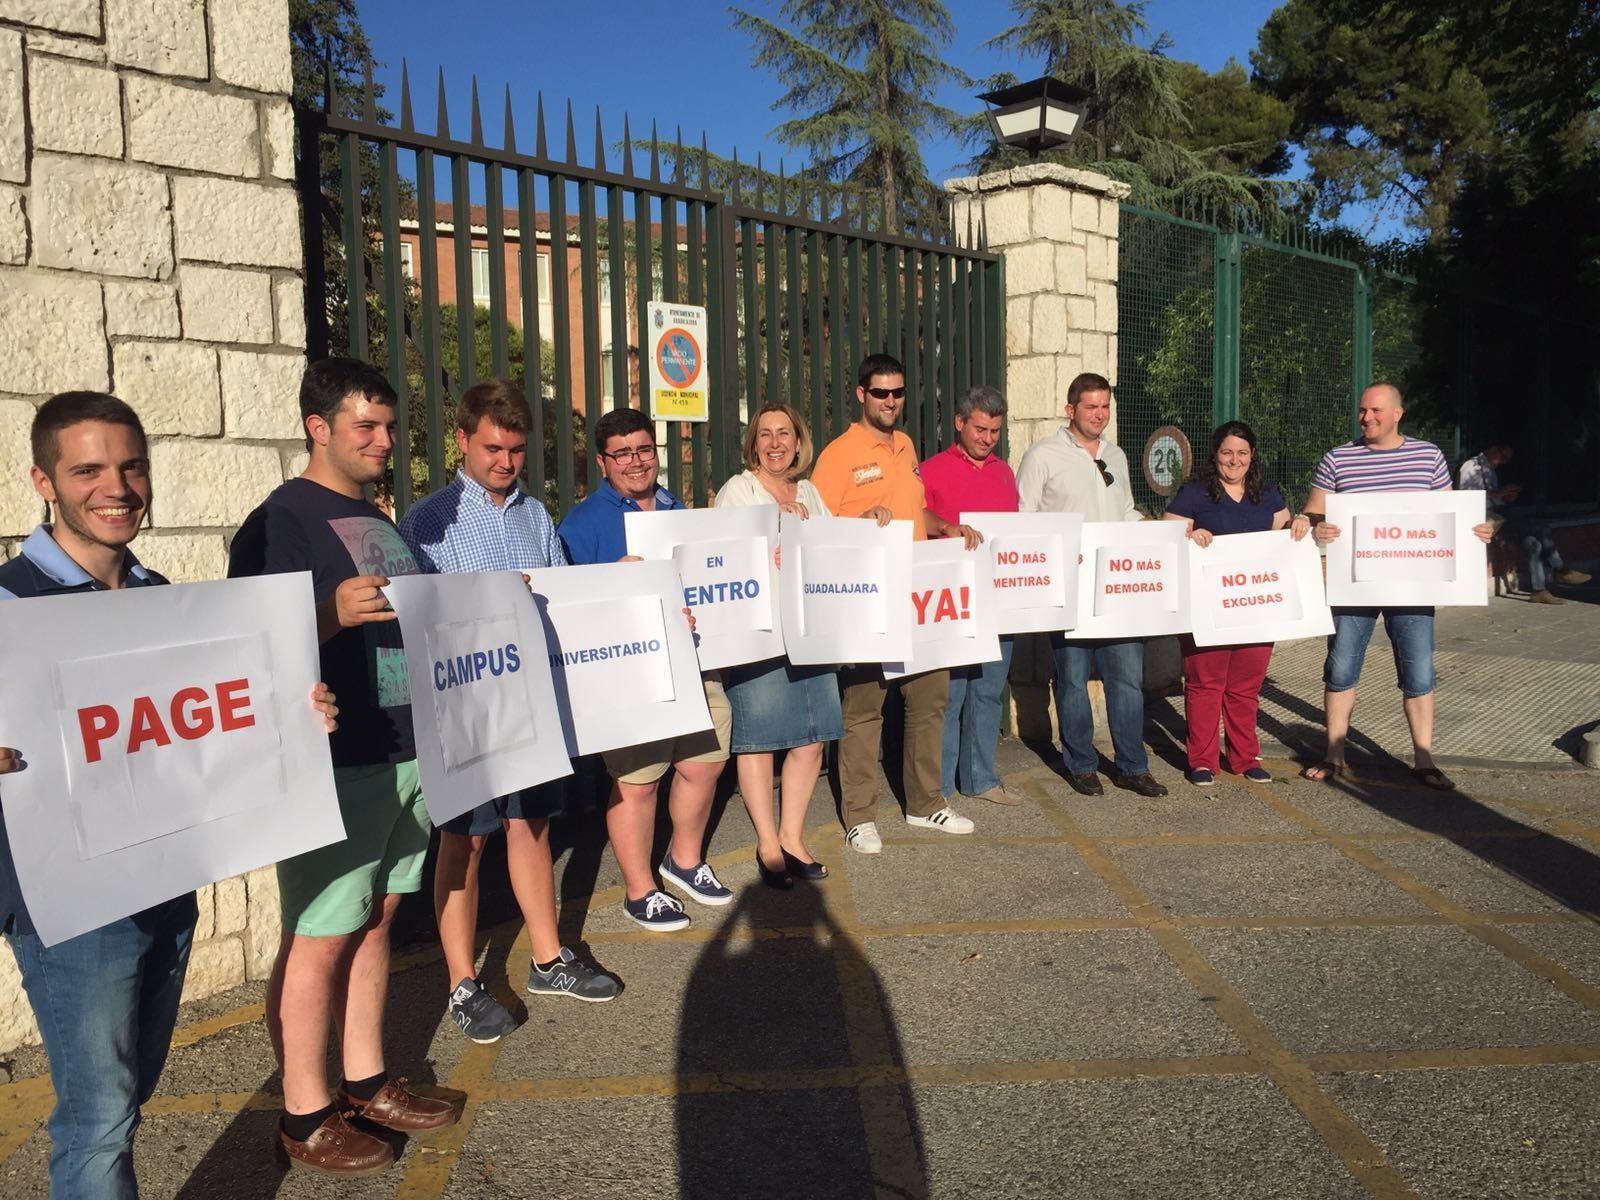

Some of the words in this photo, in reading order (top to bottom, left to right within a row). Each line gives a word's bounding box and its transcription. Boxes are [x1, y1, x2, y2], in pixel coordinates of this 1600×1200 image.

[1154, 448, 1177, 474] 20
[1373, 526, 1402, 540] NO
[1406, 527, 1438, 540] MÁS
[997, 551, 1019, 565] NO
[1022, 551, 1047, 564] MÁS
[1355, 548, 1454, 559] DISCRIMINACIÓN
[706, 555, 724, 569] EN
[1109, 558, 1133, 573] NO
[1136, 558, 1162, 571] MÁS
[1221, 573, 1247, 588] NO
[1251, 571, 1280, 585] MÁS
[684, 578, 761, 607] ENTRO
[804, 583, 879, 595] GUADALAJARA
[1105, 581, 1164, 595] DEMORAS
[911, 586, 971, 626] YA!
[1222, 592, 1284, 609] EXCUSAS
[433, 642, 521, 692] CAMPUS
[77, 677, 256, 764] PAGE
